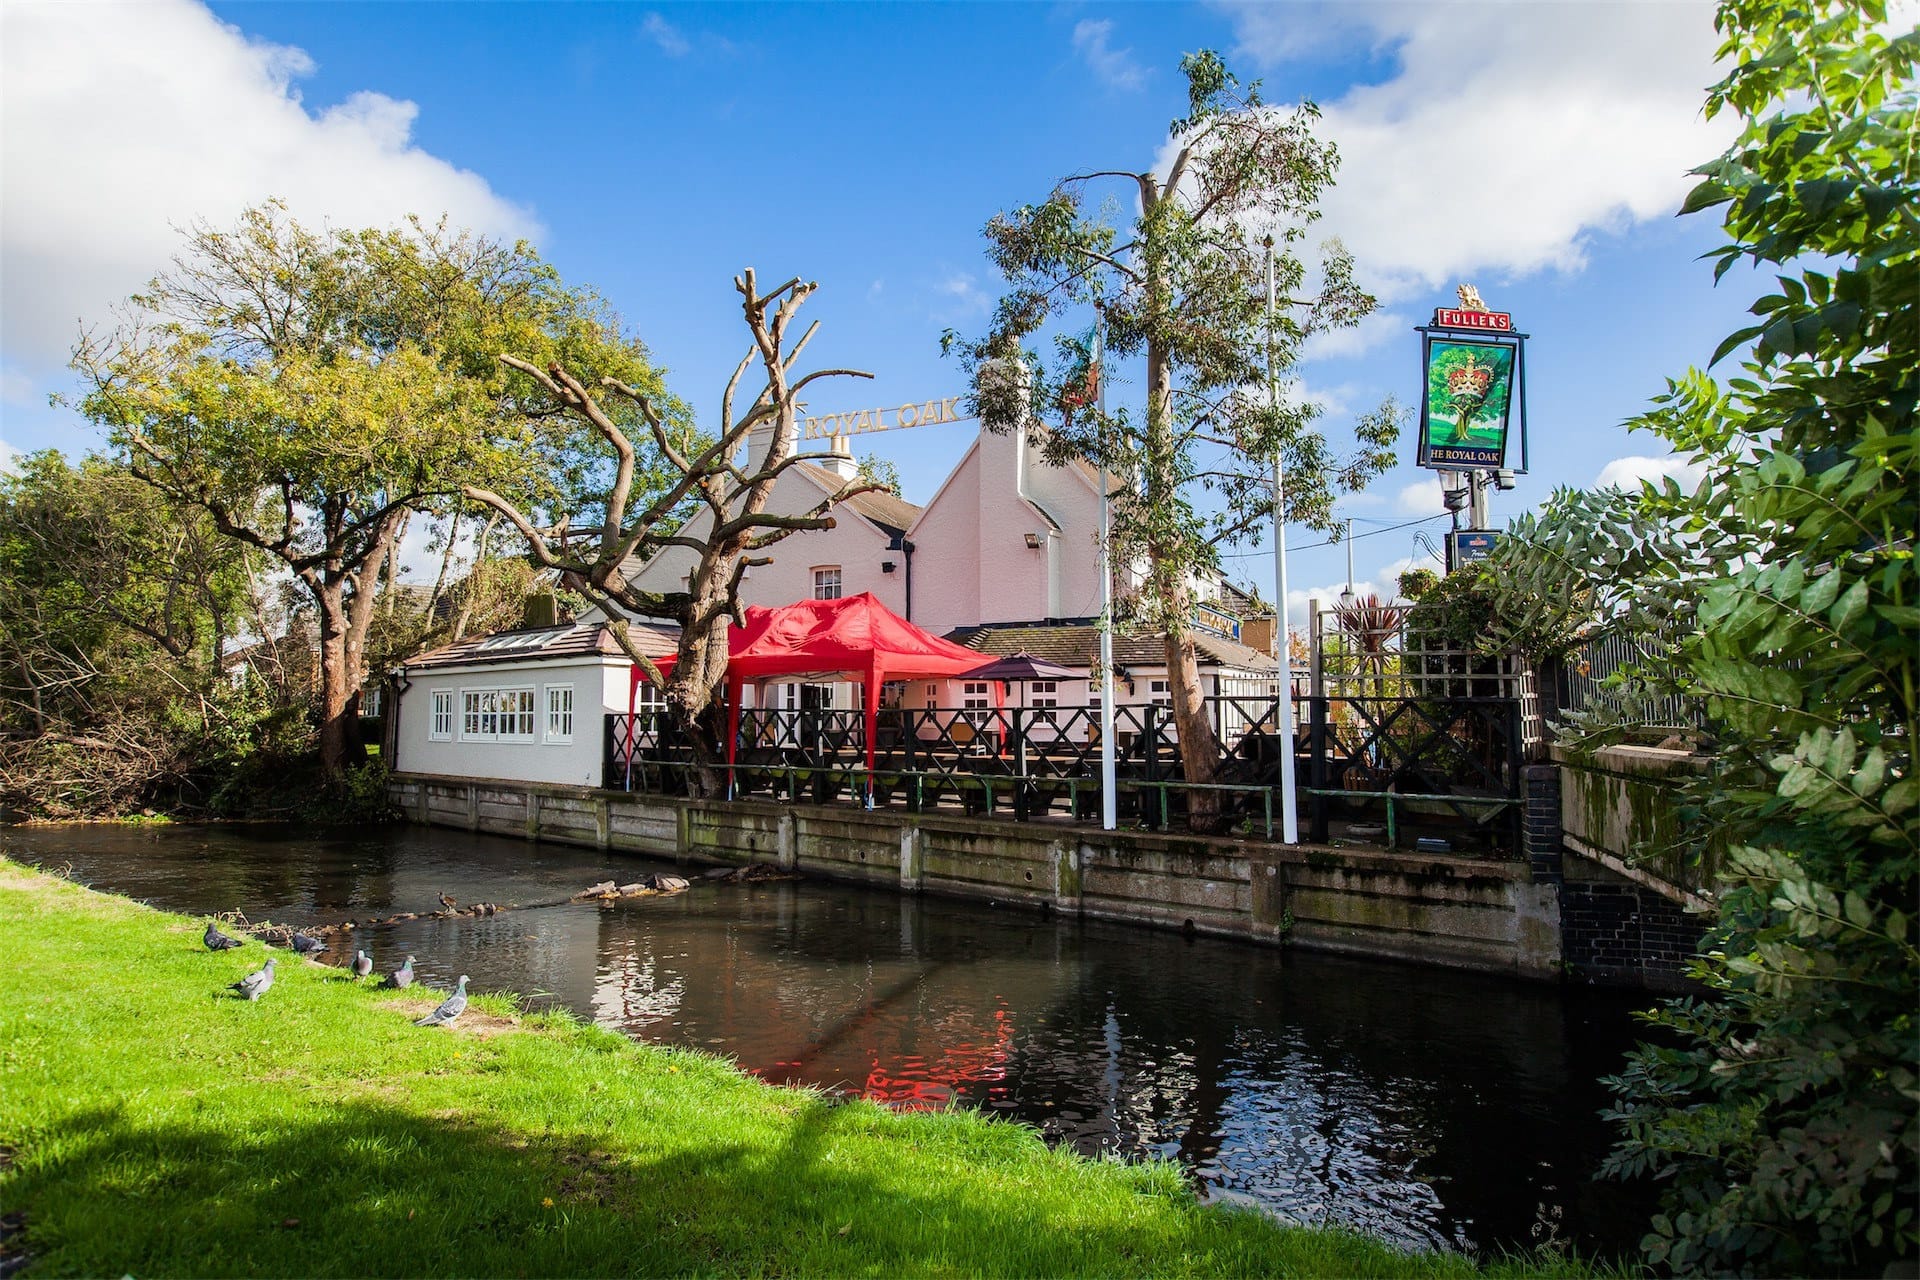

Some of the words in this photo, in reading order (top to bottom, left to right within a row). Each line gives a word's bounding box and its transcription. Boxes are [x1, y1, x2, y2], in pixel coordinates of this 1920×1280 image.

[1443, 311, 1507, 327] FULLER'S
[804, 408, 888, 440] ROYAL
[897, 396, 960, 428] OAK
[1431, 449, 1444, 459] HE
[1446, 450, 1476, 460] ROYAL
[1478, 451, 1499, 461] OAK
